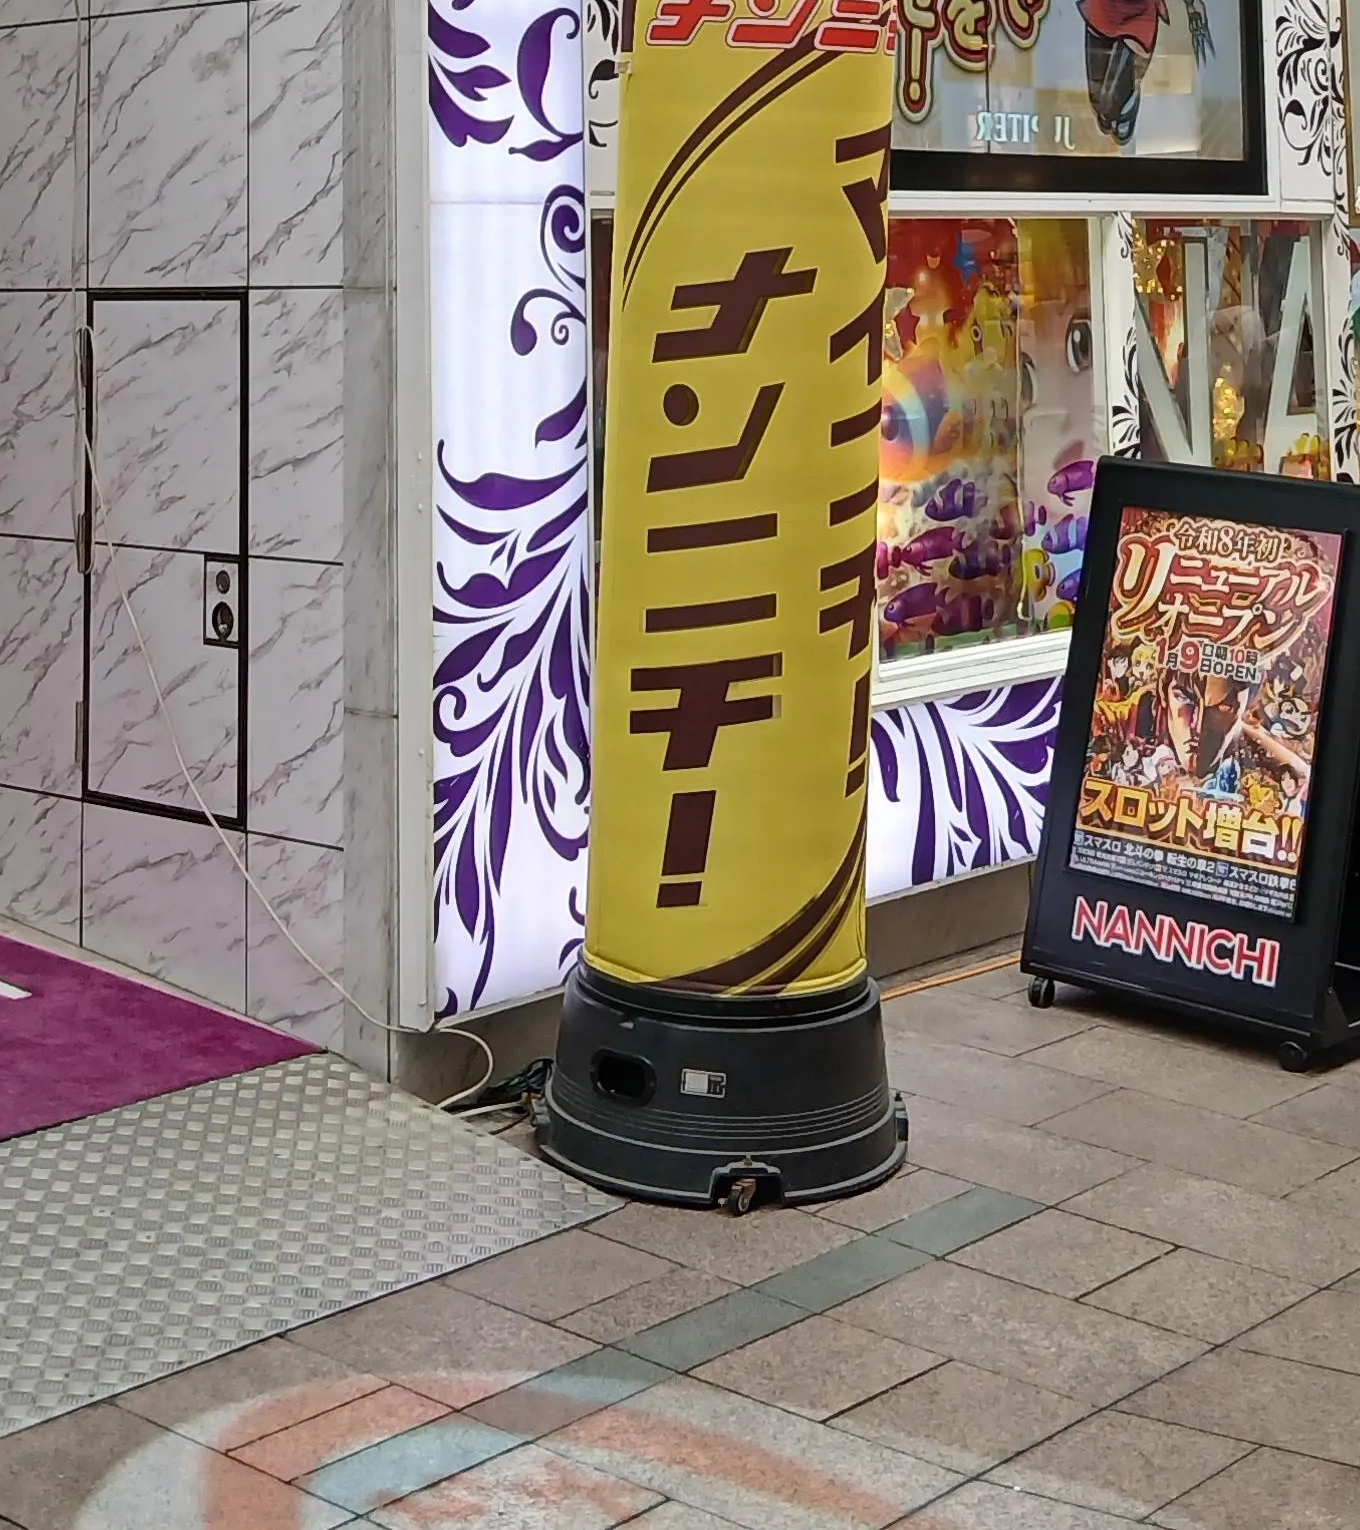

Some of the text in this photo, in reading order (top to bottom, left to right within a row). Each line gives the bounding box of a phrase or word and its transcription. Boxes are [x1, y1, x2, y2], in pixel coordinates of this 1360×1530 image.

[1175, 524, 1281, 564] 令和8年初
[1119, 542, 1328, 628] リニューアル
[1148, 592, 1300, 650] オープン
[1212, 661, 1257, 681] OPEN
[1072, 895, 1280, 988] NANNICHI
